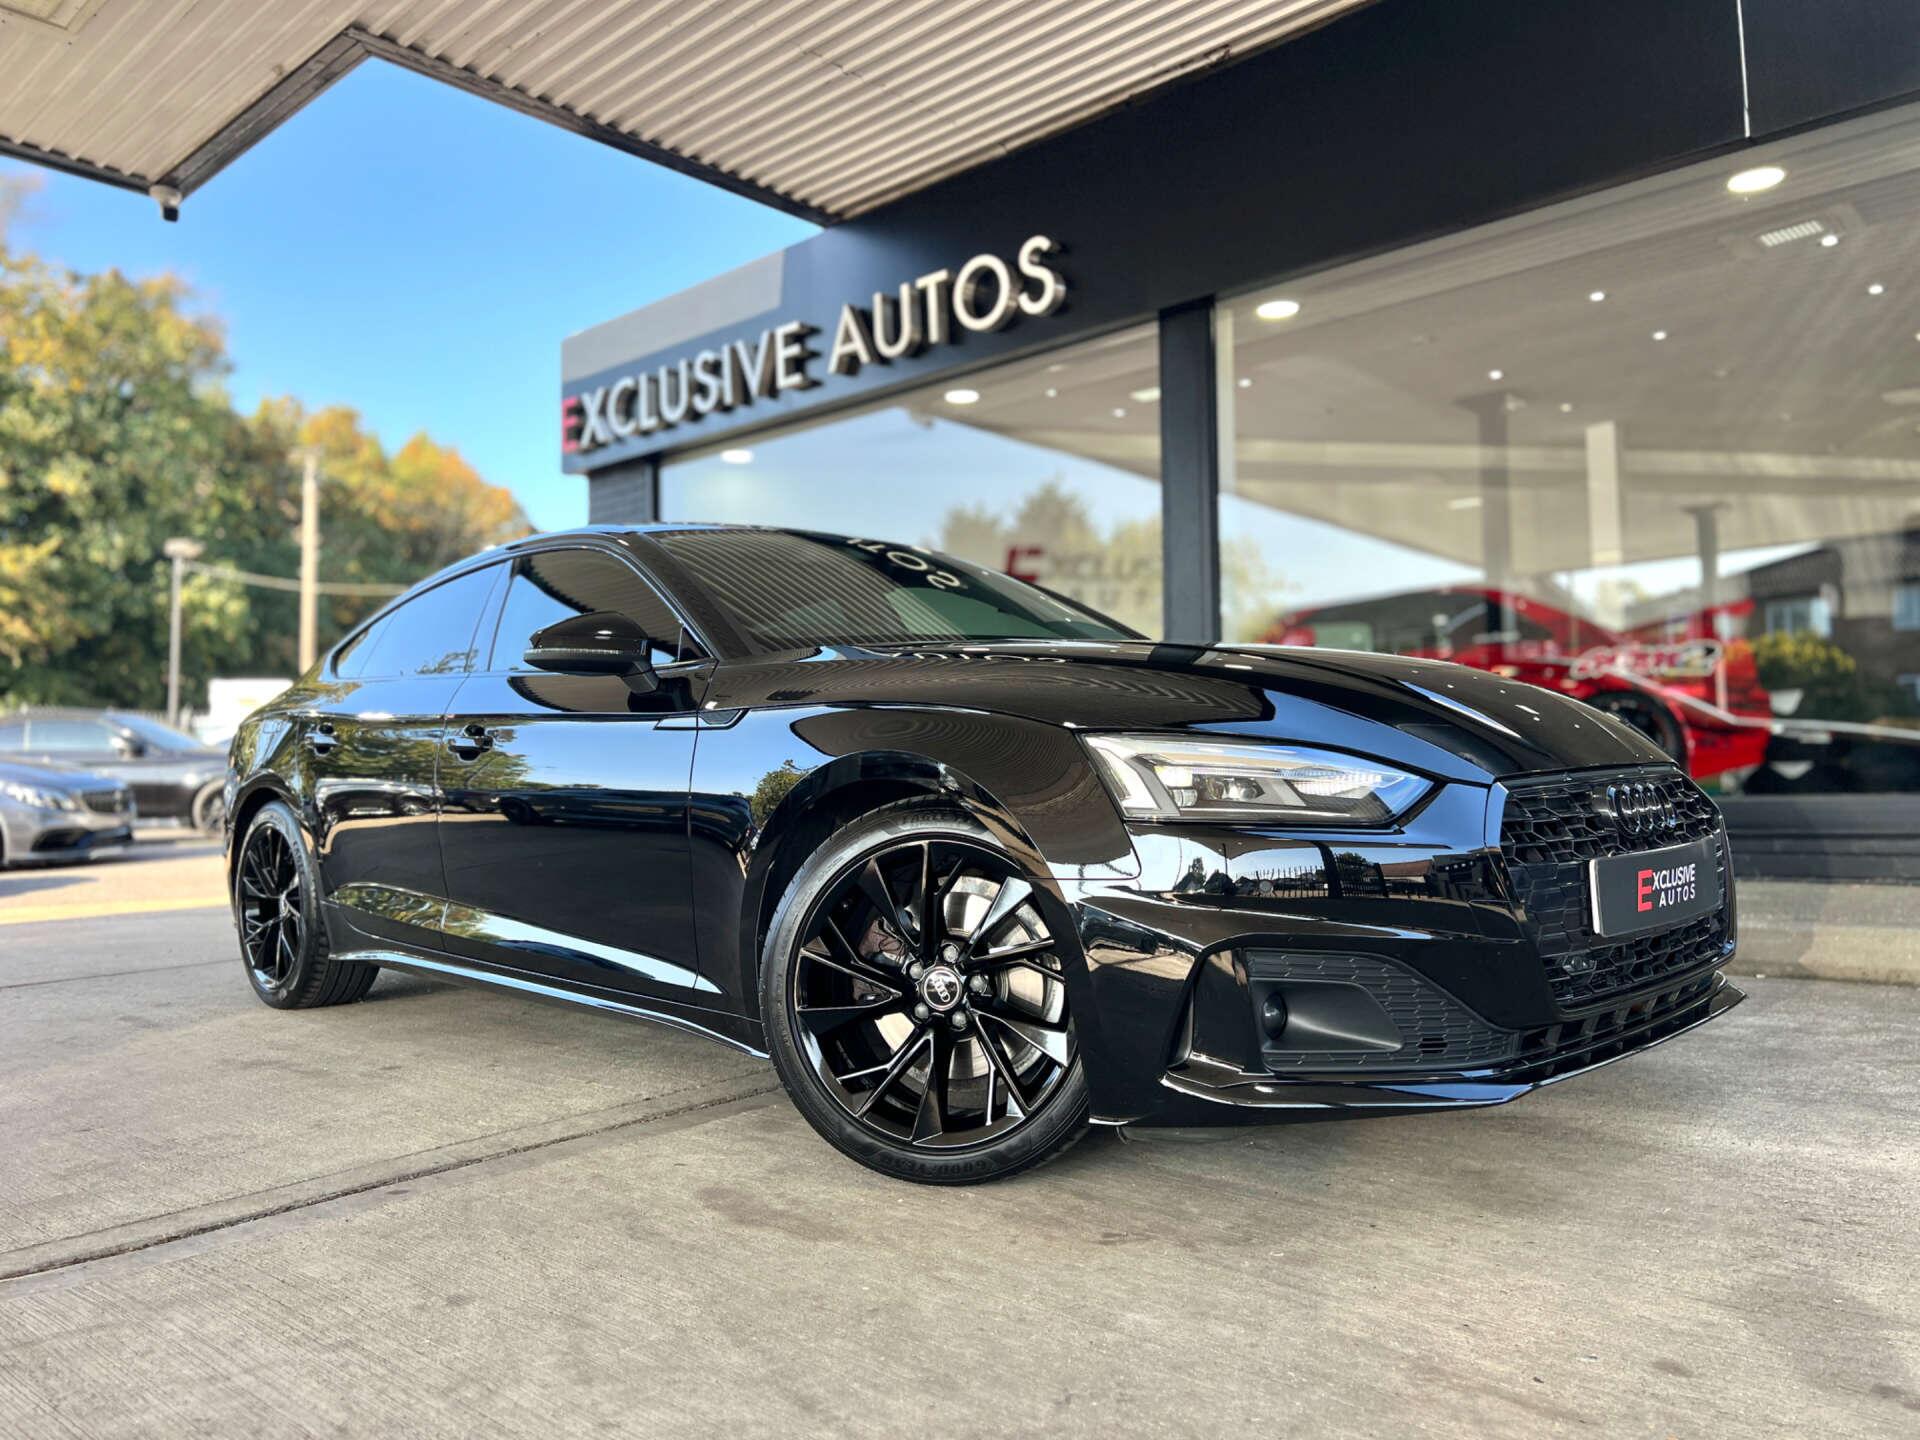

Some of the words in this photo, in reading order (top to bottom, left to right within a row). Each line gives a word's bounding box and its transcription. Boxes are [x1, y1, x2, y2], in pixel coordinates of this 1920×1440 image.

[562, 320, 808, 453] EXCLUSIVE
[828, 235, 1063, 375] AUTOS
[1637, 863, 1696, 912] EXCLUSIVE
[1659, 884, 1696, 908] AUTOS
